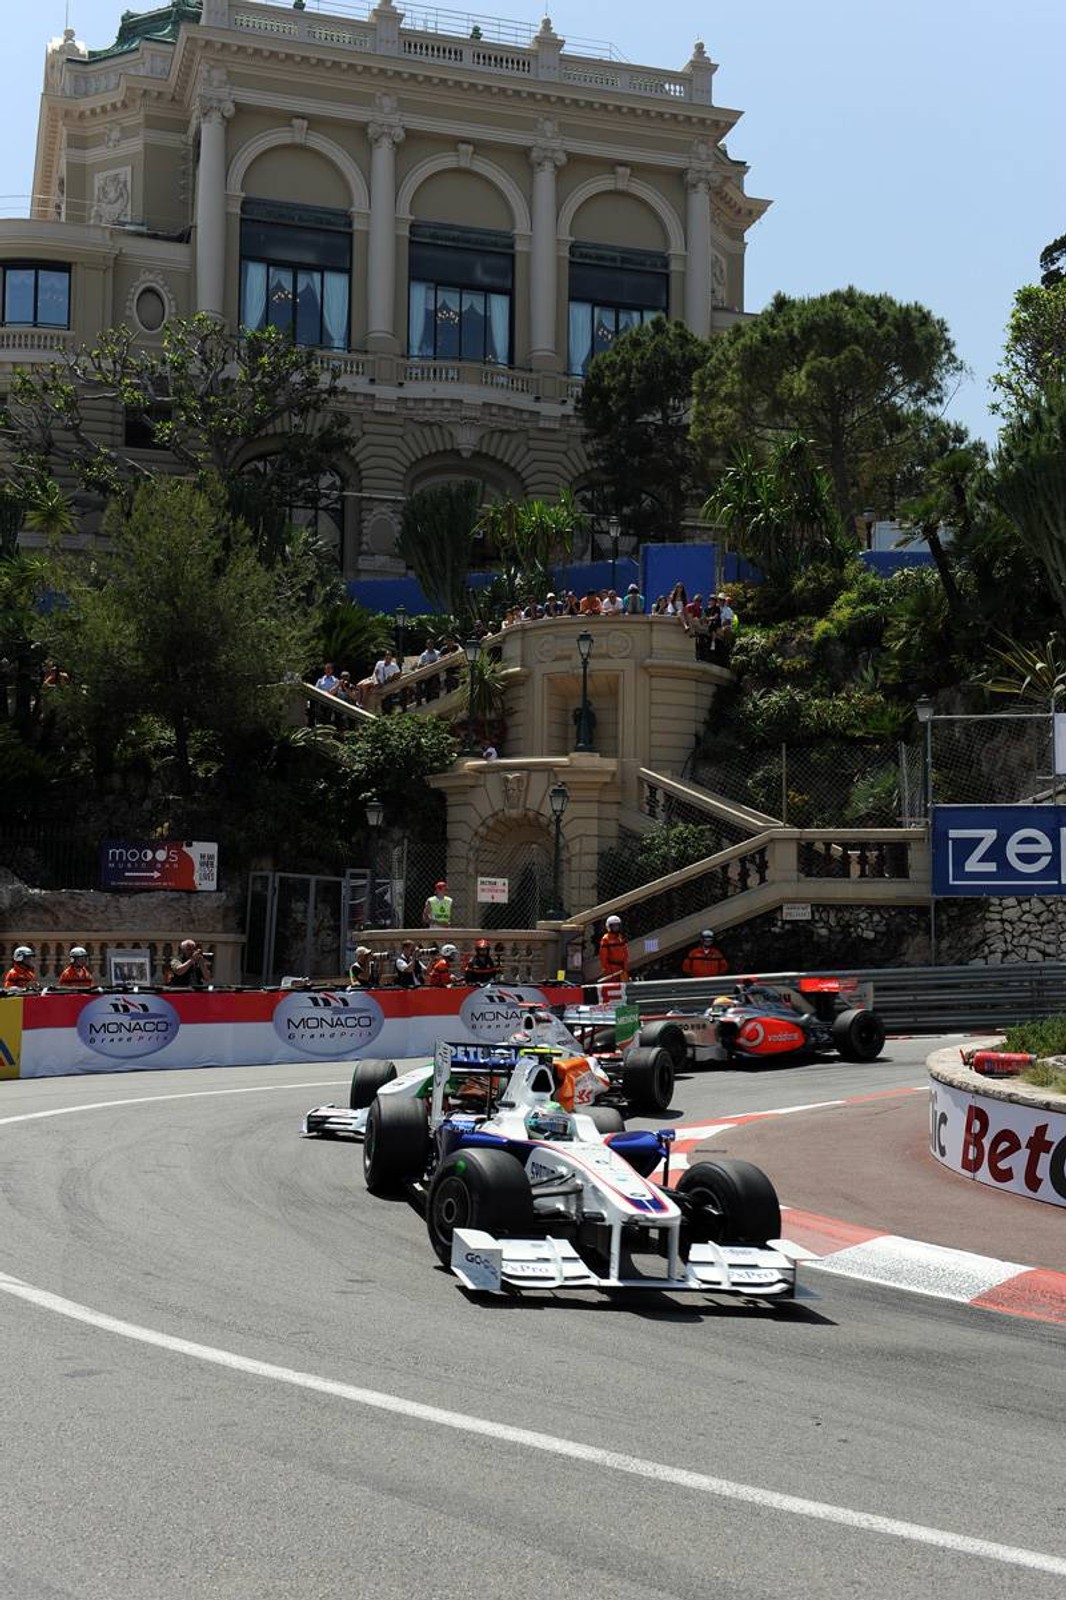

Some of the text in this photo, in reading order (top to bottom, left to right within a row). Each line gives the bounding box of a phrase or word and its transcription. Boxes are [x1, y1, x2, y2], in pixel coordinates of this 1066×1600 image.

[108, 846, 179, 862] moods
[949, 828, 1066, 885] ze
[89, 1020, 169, 1035] MONACO
[286, 1015, 372, 1030] MONACO
